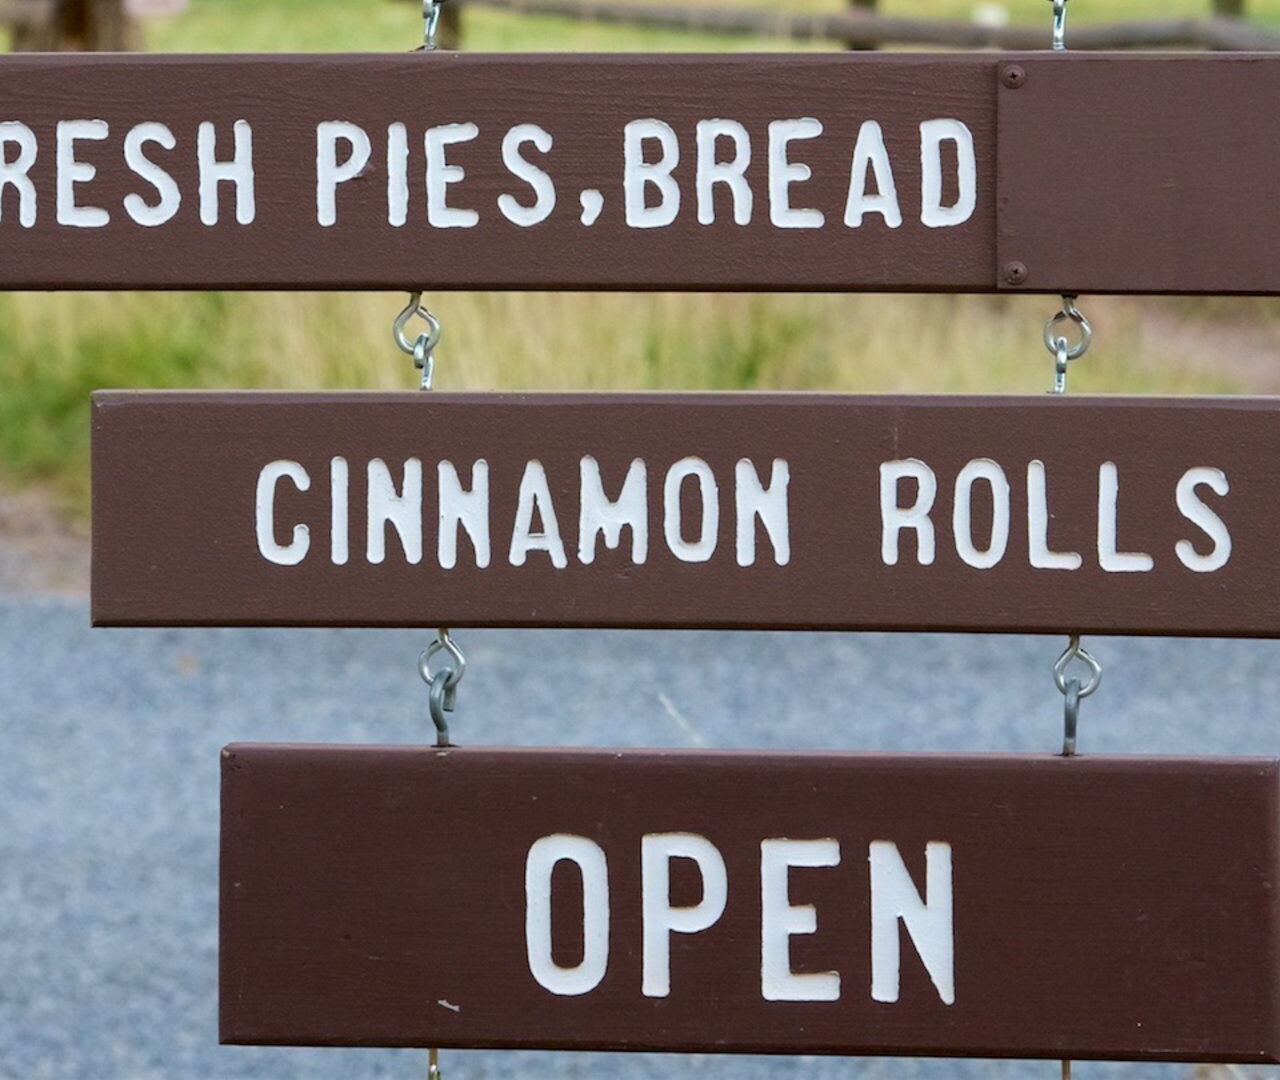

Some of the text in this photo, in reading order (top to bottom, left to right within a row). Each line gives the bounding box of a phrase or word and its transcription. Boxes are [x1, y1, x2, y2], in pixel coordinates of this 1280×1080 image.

[254, 455, 1233, 574] CINNAMON ROLLS
[524, 833, 956, 1006] OPEN
